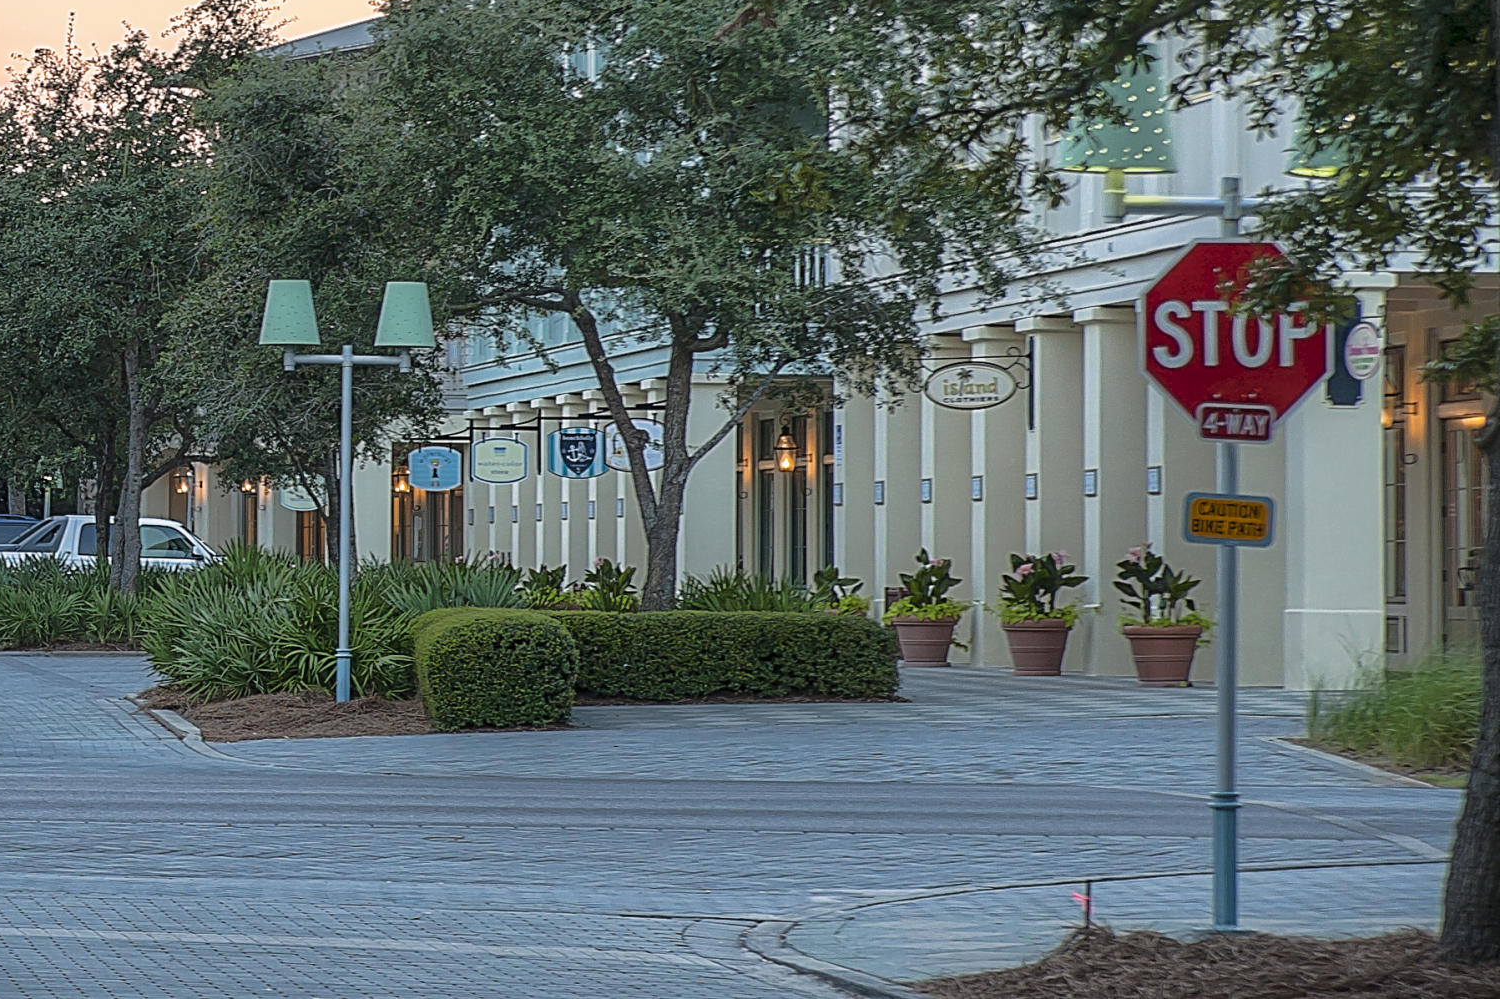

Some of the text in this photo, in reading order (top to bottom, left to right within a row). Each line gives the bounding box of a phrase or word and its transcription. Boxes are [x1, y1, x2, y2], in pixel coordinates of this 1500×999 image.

[1152, 300, 1318, 369] STOP
[943, 370, 998, 396] island
[1202, 412, 1270, 436] 4-WAY
[1198, 501, 1262, 519] CAUTION
[1192, 518, 1264, 537] BIKE PATH
